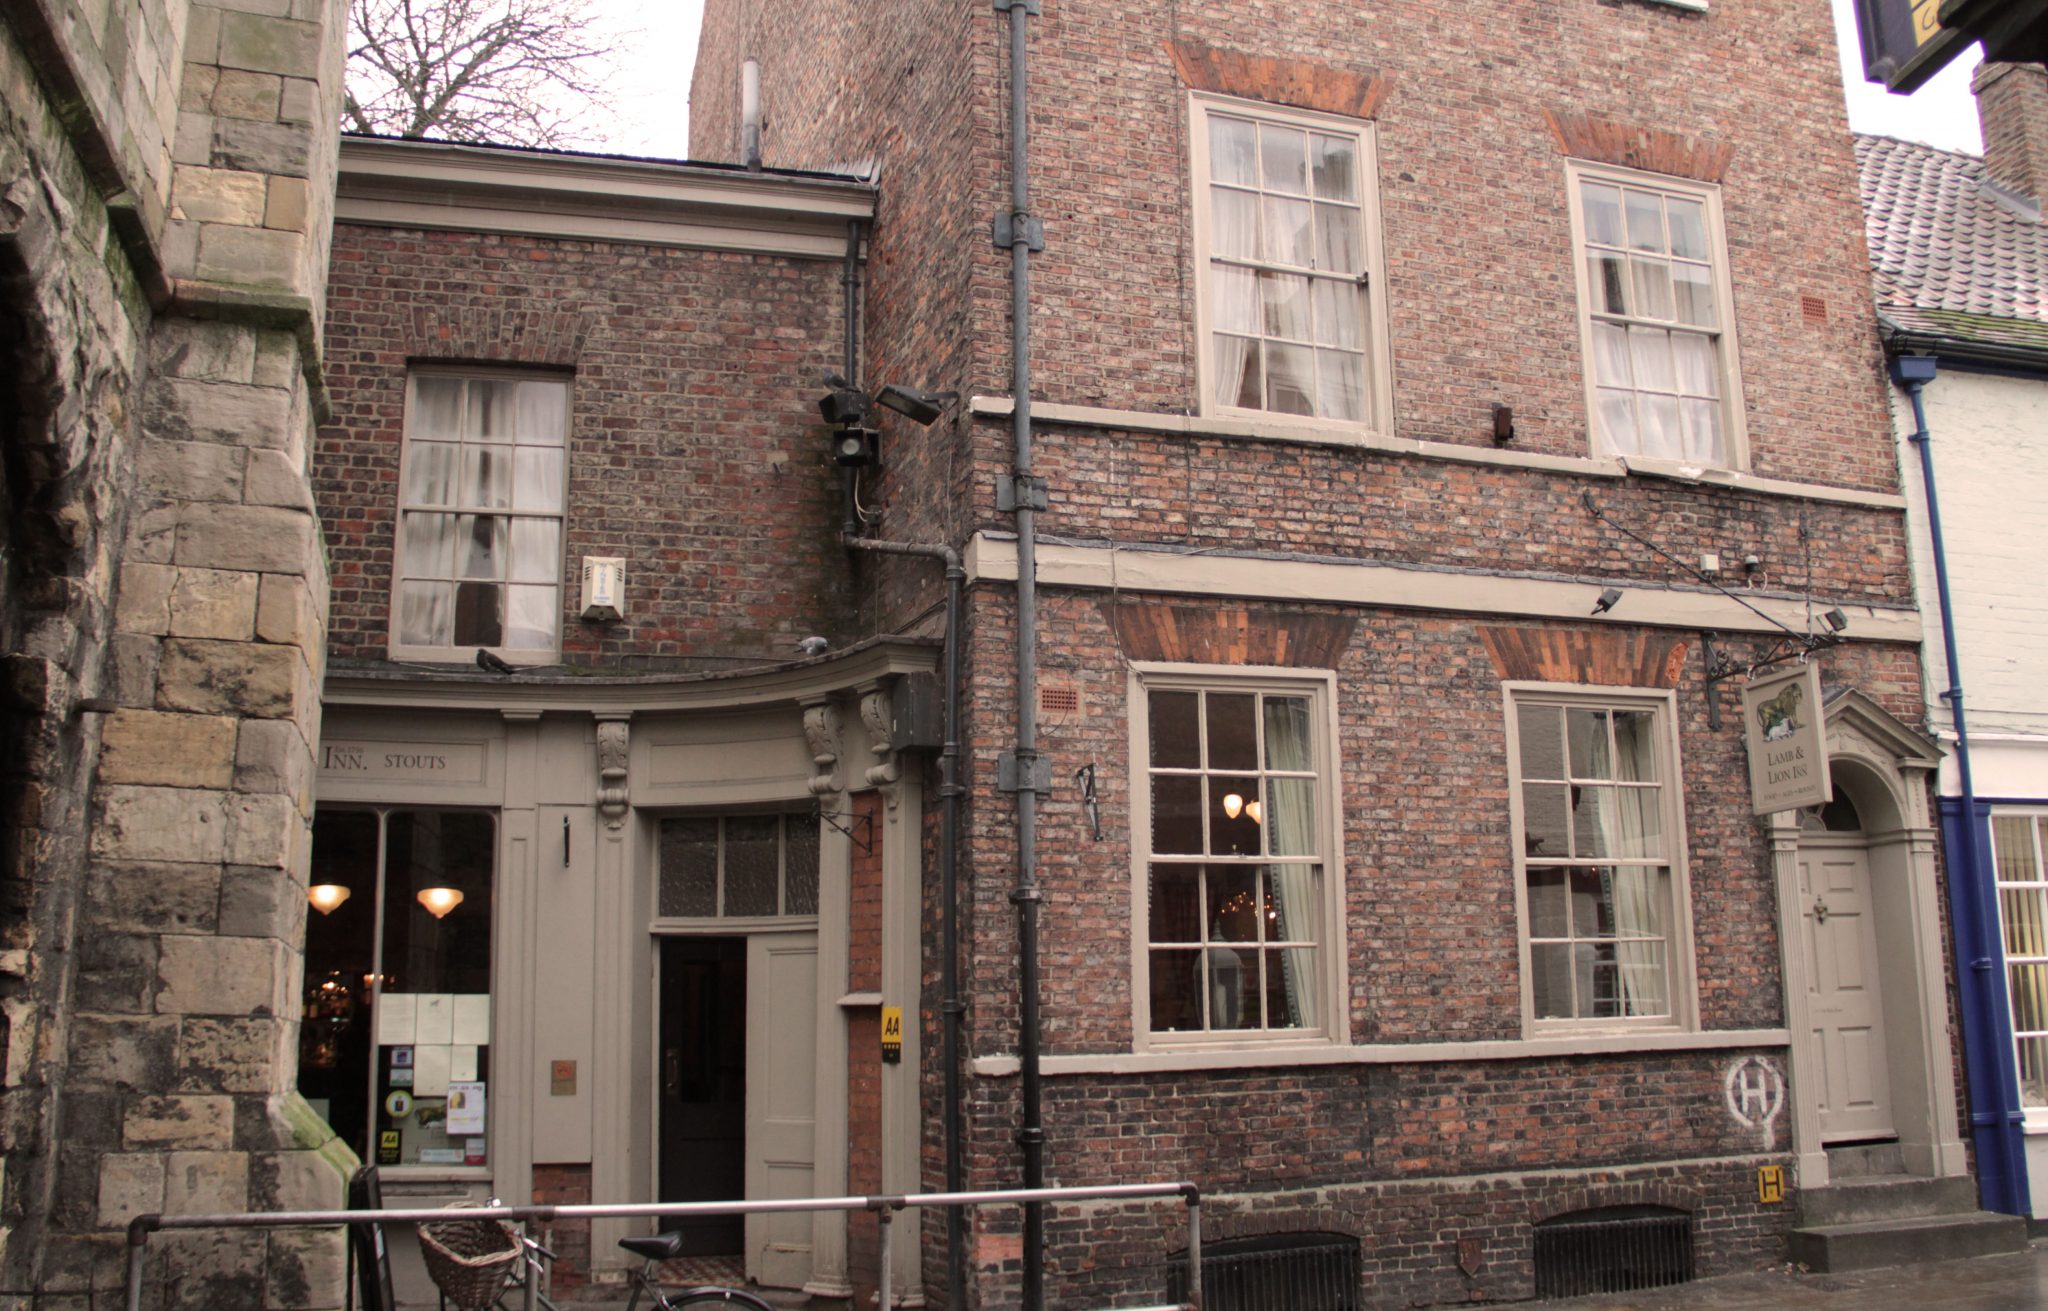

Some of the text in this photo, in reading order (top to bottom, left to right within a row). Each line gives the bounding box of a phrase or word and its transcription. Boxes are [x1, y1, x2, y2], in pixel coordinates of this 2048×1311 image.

[323, 746, 446, 771] INN. STOUTS
[1767, 745, 1805, 767] LAMB &
[1767, 769, 1791, 785] LION
[1792, 766, 1808, 779] INN
[884, 1016, 899, 1036] AA
[1740, 1069, 1767, 1114] H
[383, 1134, 397, 1145] AA
[1762, 1169, 1780, 1199] H
